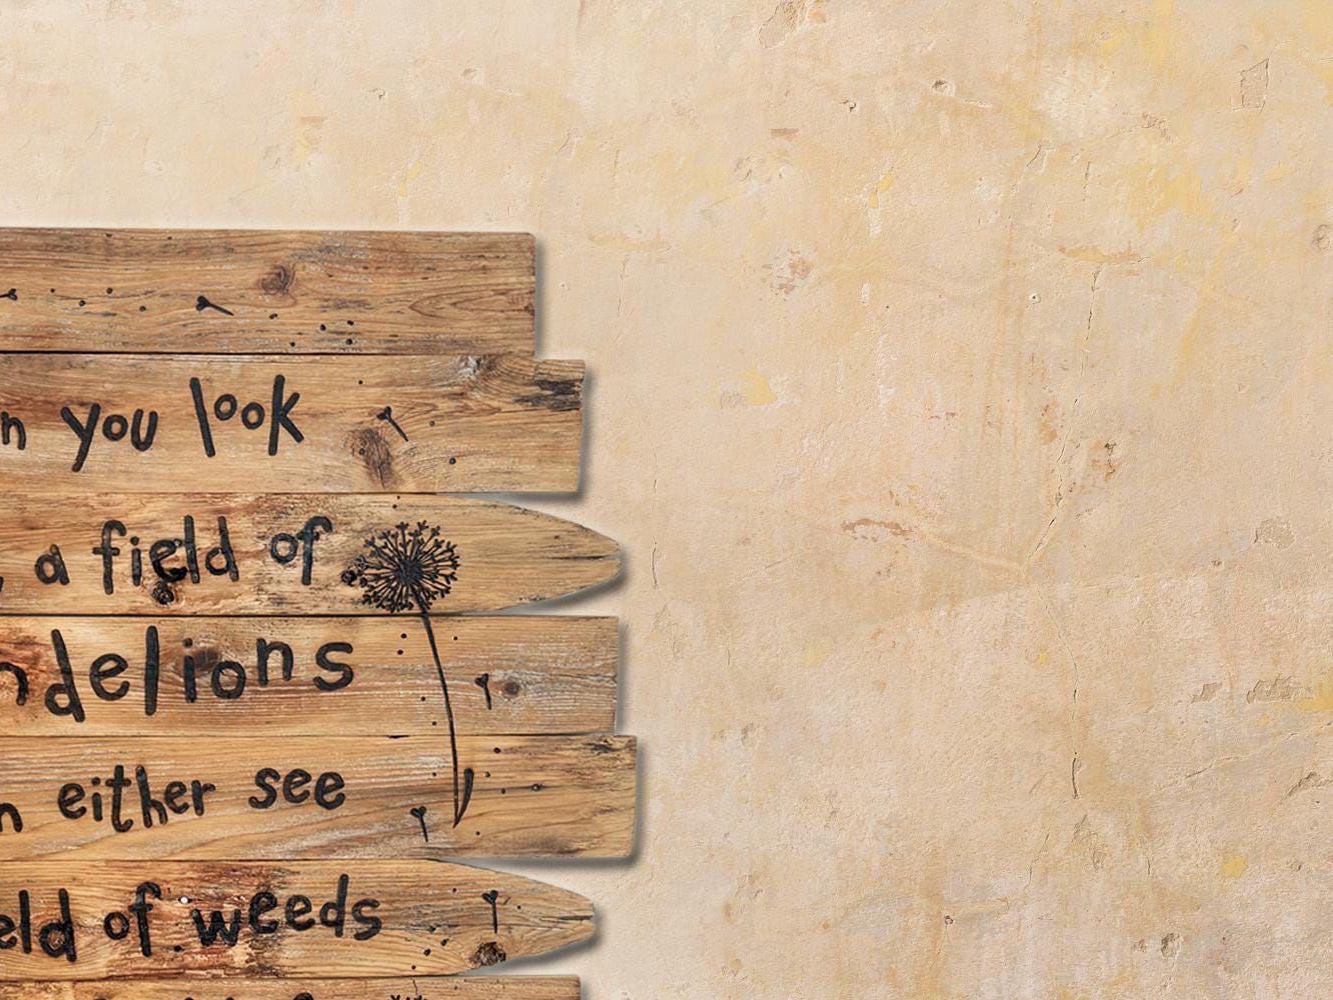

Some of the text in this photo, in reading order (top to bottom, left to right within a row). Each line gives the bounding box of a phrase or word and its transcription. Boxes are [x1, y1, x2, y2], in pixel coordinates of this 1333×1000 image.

[62, 402, 159, 473] you
[190, 373, 305, 457] look
[34, 543, 70, 586] a
[92, 515, 240, 594] field
[269, 515, 333, 586] of
[57, 764, 217, 833] either
[248, 766, 346, 810] see
[103, 881, 162, 957] of
[190, 873, 383, 948] weeds
